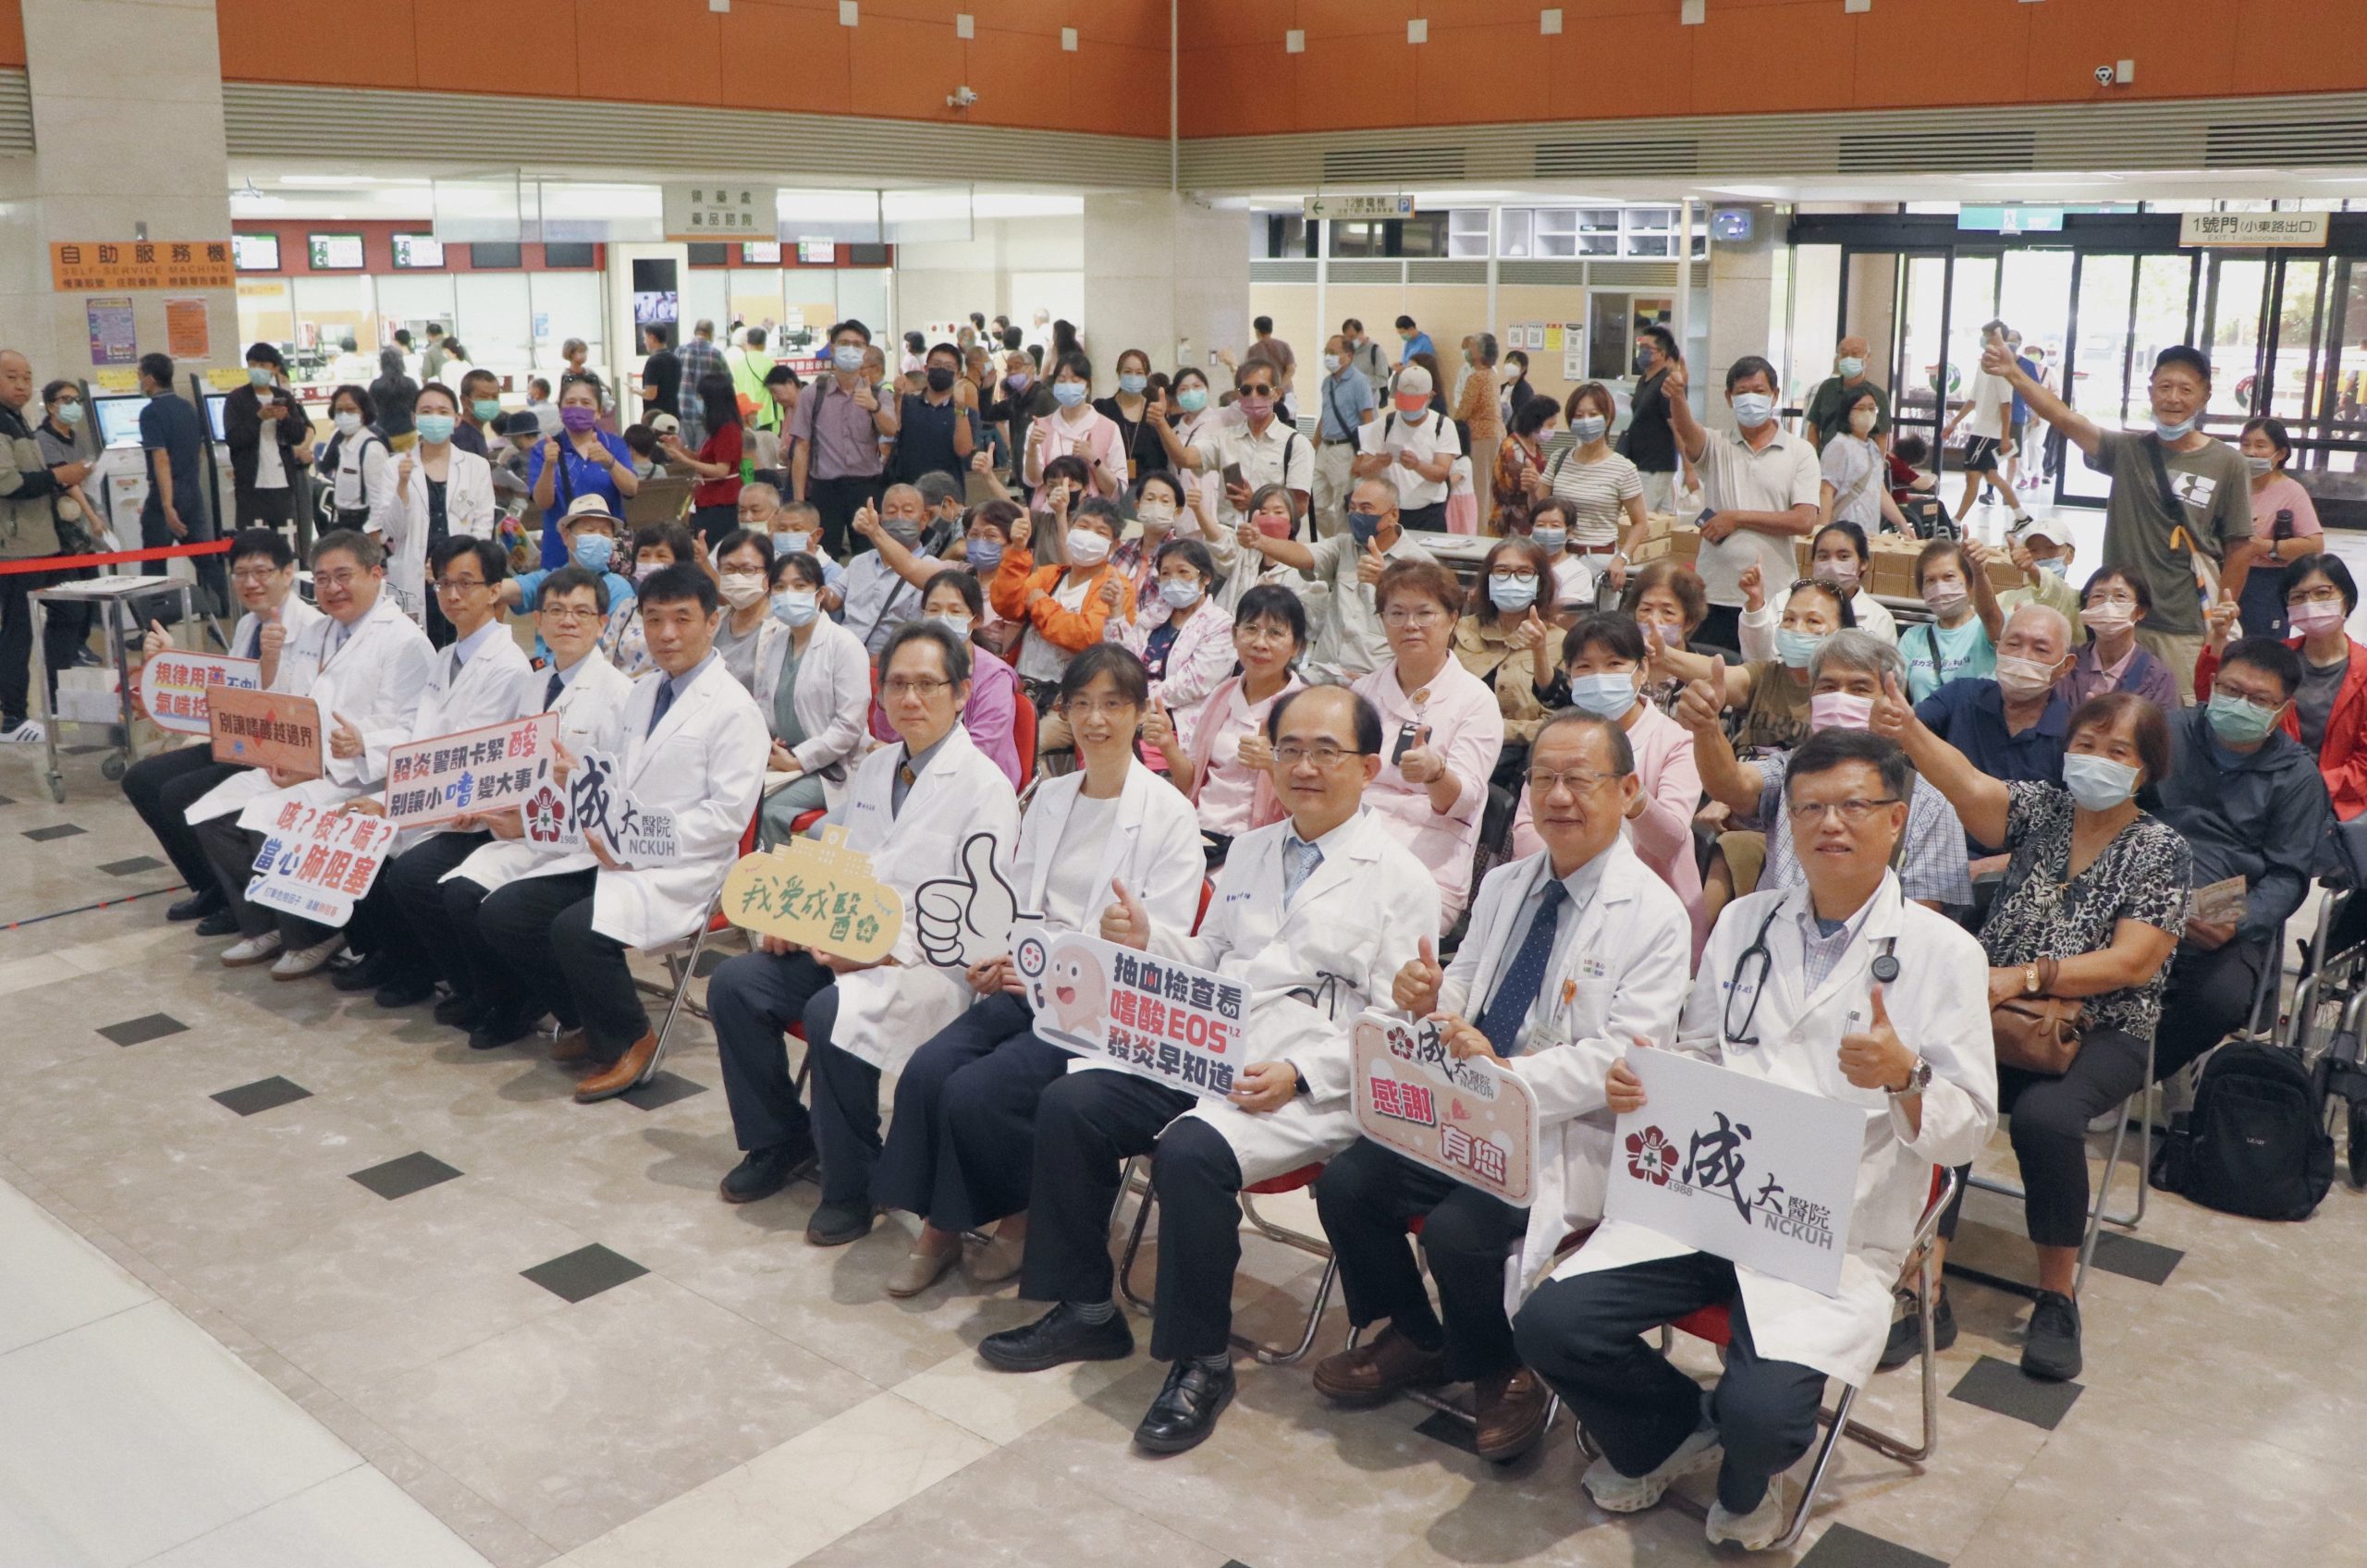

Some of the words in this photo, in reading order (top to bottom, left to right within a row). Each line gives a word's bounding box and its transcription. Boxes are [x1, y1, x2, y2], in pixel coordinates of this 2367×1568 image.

[61, 243, 227, 264] 自助服務機
[168, 264, 227, 274] MACHINE
[219, 712, 312, 749] 別讓嗜酸越過界
[393, 722, 538, 783] 發炎警訊卡緊酸
[560, 835, 579, 845] 1988
[629, 839, 676, 857] NCKUH
[254, 838, 376, 896] 當心肺阻塞
[742, 875, 862, 942] 我愛成醫
[1113, 951, 1243, 1021] 抽血檢查看
[1108, 1025, 1234, 1096] 發炎早知道
[1370, 1076, 1433, 1123] 感謝
[1460, 1077, 1494, 1099] NCKUH
[1441, 1121, 1506, 1186] 有您
[1667, 1182, 1693, 1197] 1988
[1764, 1214, 1834, 1250] NCKUH
